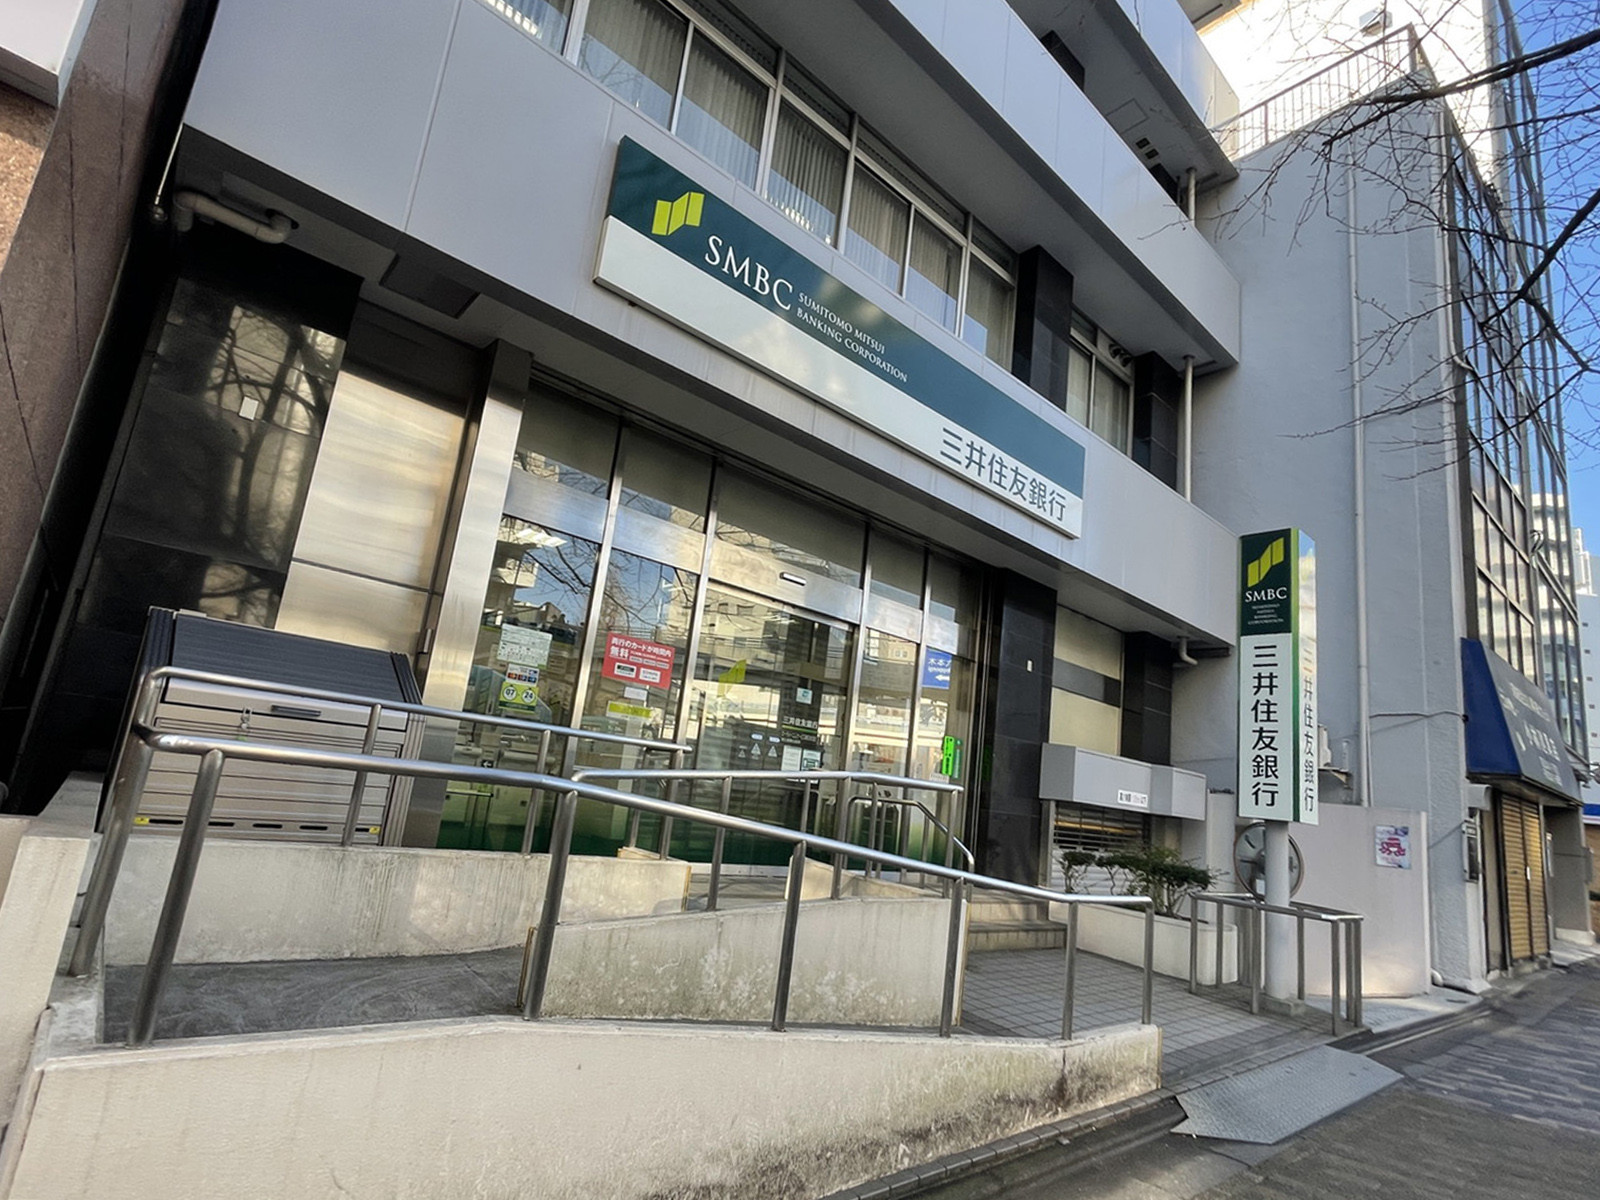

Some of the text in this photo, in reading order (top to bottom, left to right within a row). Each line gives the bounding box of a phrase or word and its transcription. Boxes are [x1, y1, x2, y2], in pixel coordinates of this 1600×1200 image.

[705, 235, 793, 311] SMBC
[797, 307, 908, 383] BANKING CORPORATION
[798, 292, 886, 355] SUMITOMO MITSUI
[940, 427, 1066, 522] 三井住友銀行
[1245, 586, 1288, 603] SMBC
[505, 688, 516, 697] 07
[1251, 645, 1279, 807] 三井住友銀行
